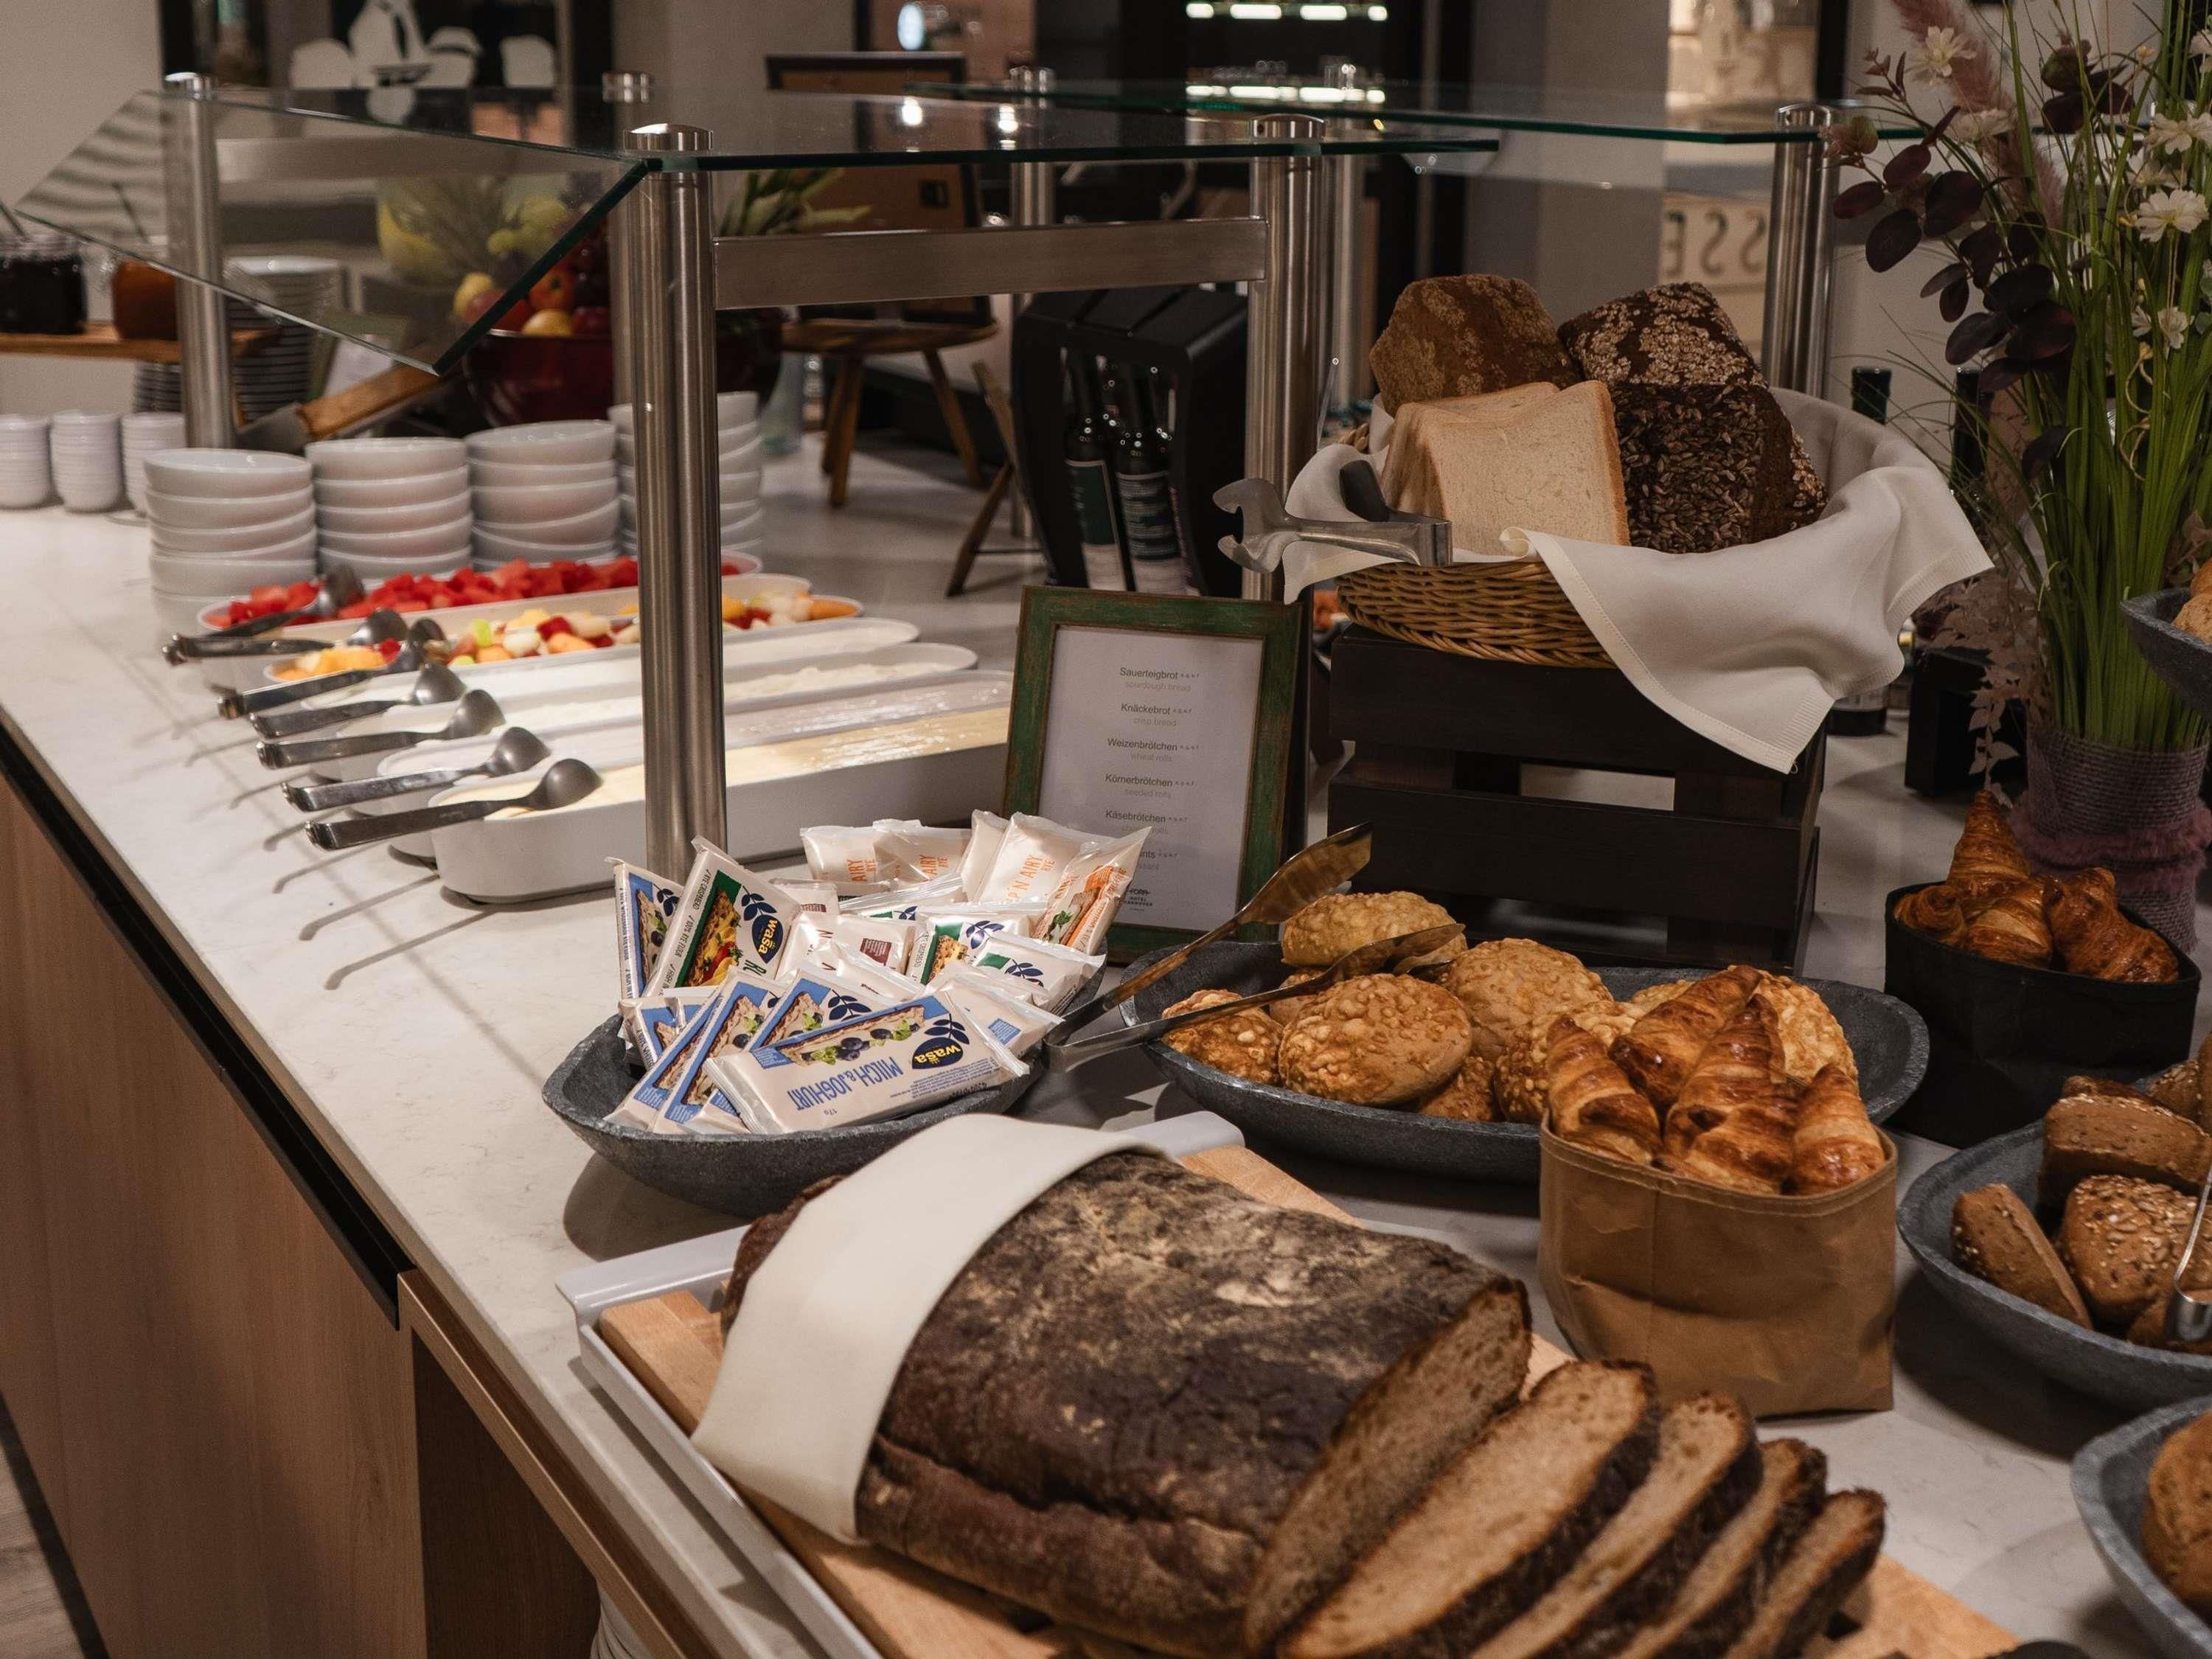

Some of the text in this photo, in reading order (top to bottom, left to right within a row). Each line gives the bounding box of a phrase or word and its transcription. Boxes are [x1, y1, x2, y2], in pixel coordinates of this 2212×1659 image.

[1120, 667, 1178, 680] Sauerteigbrot
[1121, 703, 1171, 714] Knäckebrot
[1107, 737, 1178, 751] Weizenbrötchen
[1105, 773, 1173, 787] Körnerbrötchen
[1106, 810, 1166, 823] Käsebrötchen
[847, 859, 868, 883] AIRY
[920, 854, 938, 876] AIRY
[1020, 854, 1044, 879] AIRY
[759, 919, 778, 955] wasa
[914, 1044, 961, 1063] wasa
[846, 1071, 855, 1082] &
[857, 1056, 904, 1087] MILCH
[786, 1070, 853, 1110] JOGHURT
